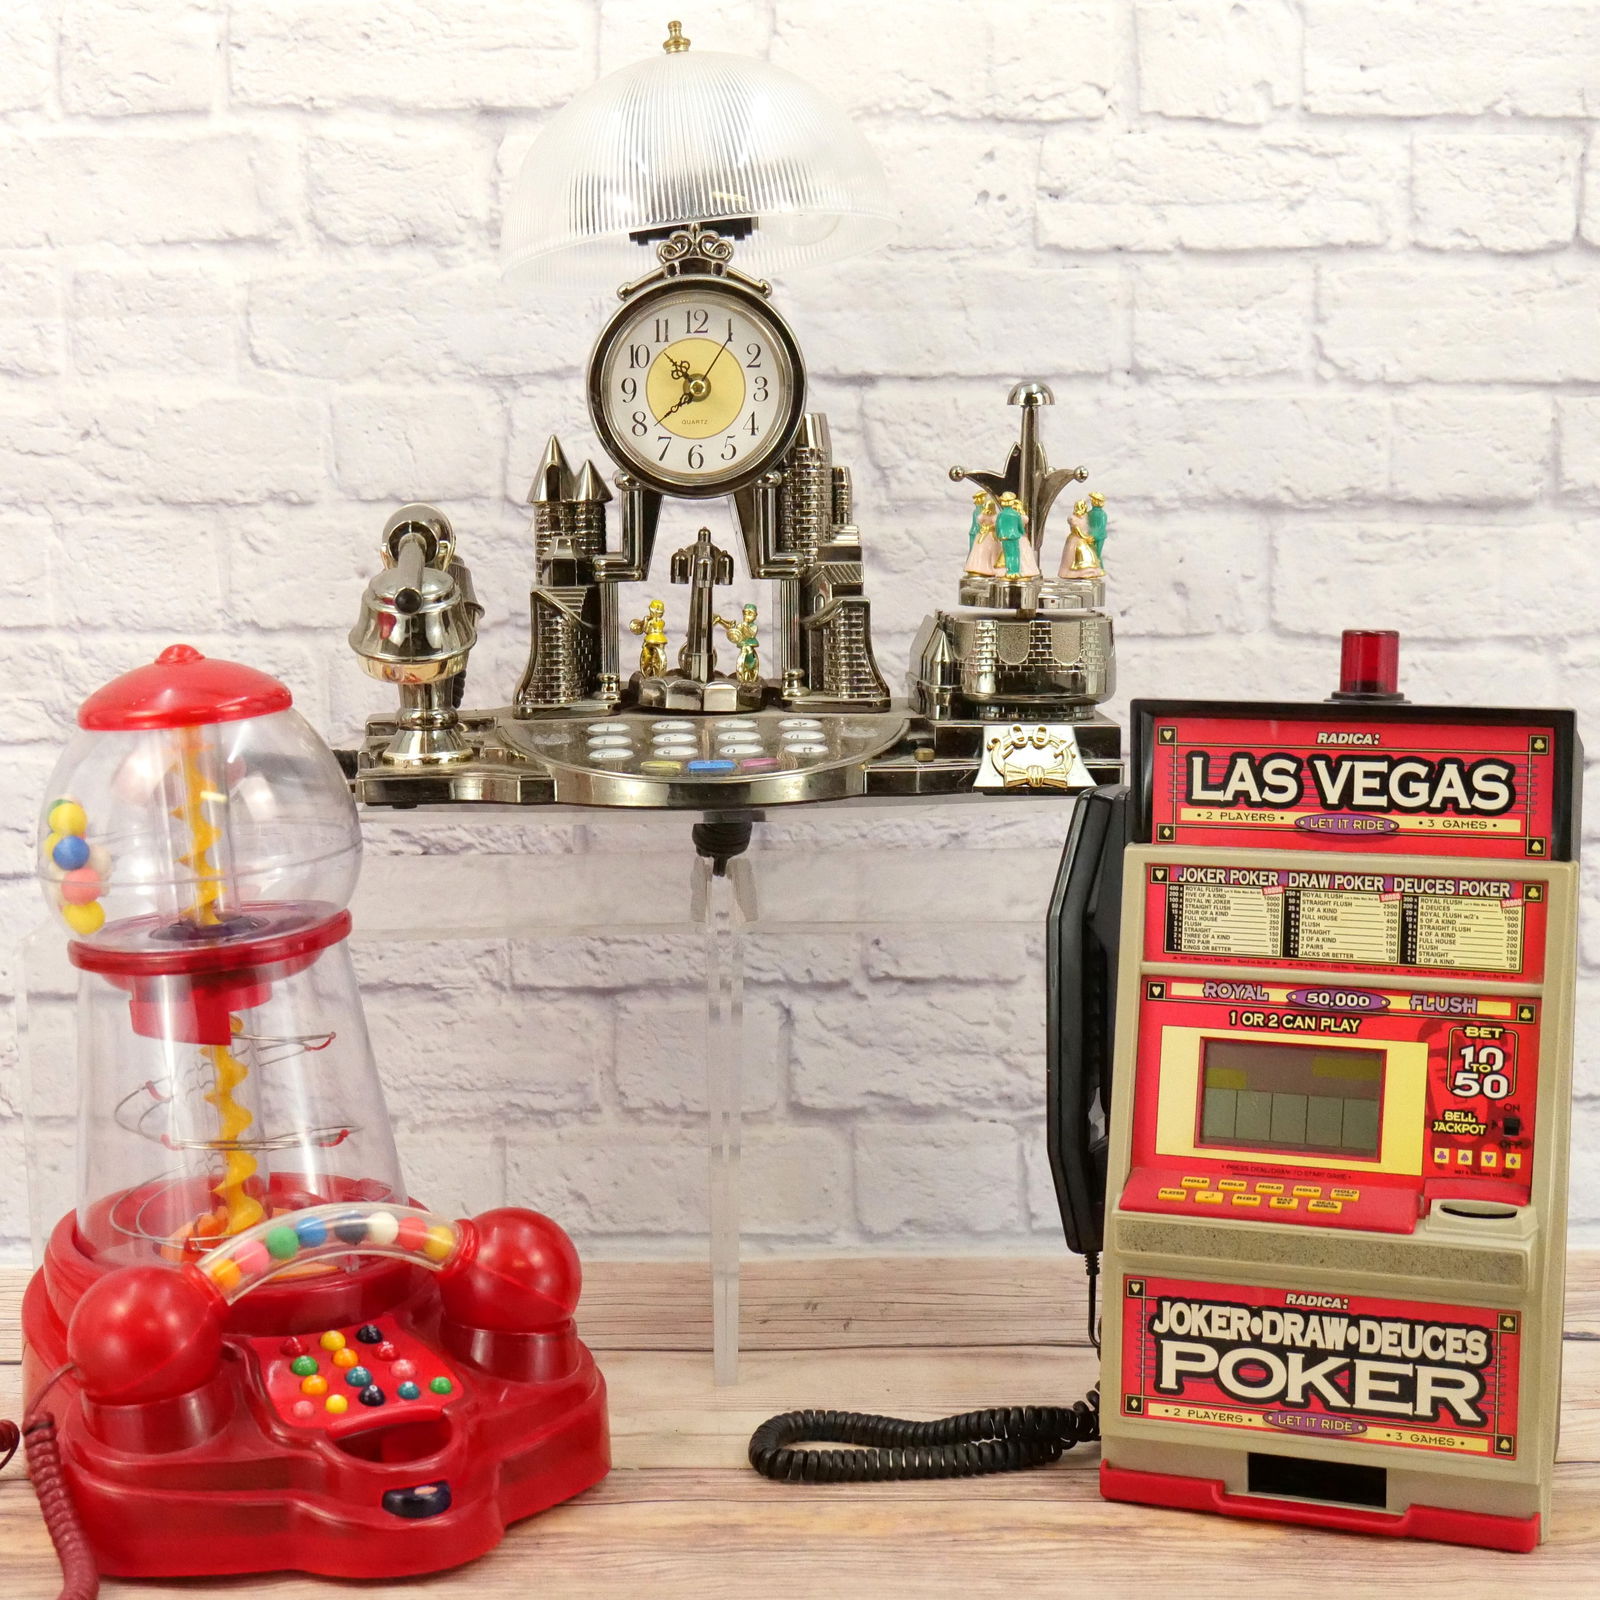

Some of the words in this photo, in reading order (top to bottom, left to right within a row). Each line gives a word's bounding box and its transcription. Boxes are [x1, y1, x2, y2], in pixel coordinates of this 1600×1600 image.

[655, 318, 668, 342] 11
[686, 310, 708, 333] 12
[727, 319, 733, 342] 1
[629, 344, 650, 368] 10
[746, 343, 762, 368] 2
[621, 377, 636, 403] 9
[753, 376, 768, 402] 3
[632, 411, 647, 436] 8
[743, 411, 759, 436] 4
[657, 436, 671, 461] 7
[688, 444, 704, 469] 6
[721, 435, 736, 460] 5
[1316, 732, 1380, 746] RADICA:
[1190, 756, 1300, 803] LAS
[1311, 758, 1512, 812] VEGAS
[1206, 812, 1213, 821] 2
[1220, 812, 1276, 823] PLAYERS
[1309, 818, 1335, 829] LET
[1337, 819, 1350, 830] IT
[1353, 820, 1385, 831] RIDE
[1427, 819, 1434, 828] 3
[1442, 819, 1488, 830] GAMES
[1179, 868, 1226, 883] JOKER
[1230, 870, 1278, 885] POKER
[1289, 872, 1330, 888] DRAW
[1334, 875, 1384, 891] POKER
[1394, 877, 1454, 894] DEUCES
[1460, 880, 1510, 897] POKER
[1203, 982, 1269, 1002] ROYAL
[1306, 992, 1370, 1008] 50,000
[1409, 995, 1478, 1015] FLUSH
[1229, 1012, 1237, 1026] 1
[1242, 1013, 1264, 1027] OR
[1268, 1015, 1278, 1028] 2
[1282, 1016, 1317, 1030] CAN
[1320, 1017, 1361, 1033] PLAY
[1465, 1026, 1503, 1039] BET
[1460, 1045, 1504, 1071] 10
[1470, 1063, 1491, 1073] TO
[1452, 1072, 1509, 1099] 50
[1444, 1111, 1476, 1123] BELL
[1504, 1103, 1520, 1112] ON
[1433, 1121, 1486, 1135] JACKPOT
[1286, 1293, 1349, 1310] RADICA:
[1159, 1340, 1481, 1423] POKER
[1173, 1408, 1182, 1416] 2
[1187, 1409, 1243, 1423] PLAYERS
[1278, 1415, 1301, 1426] LET
[1305, 1417, 1318, 1428] IT
[1321, 1418, 1353, 1432] RIDE
[1395, 1432, 1402, 1441] 3
[1411, 1434, 1455, 1447] GAMES
